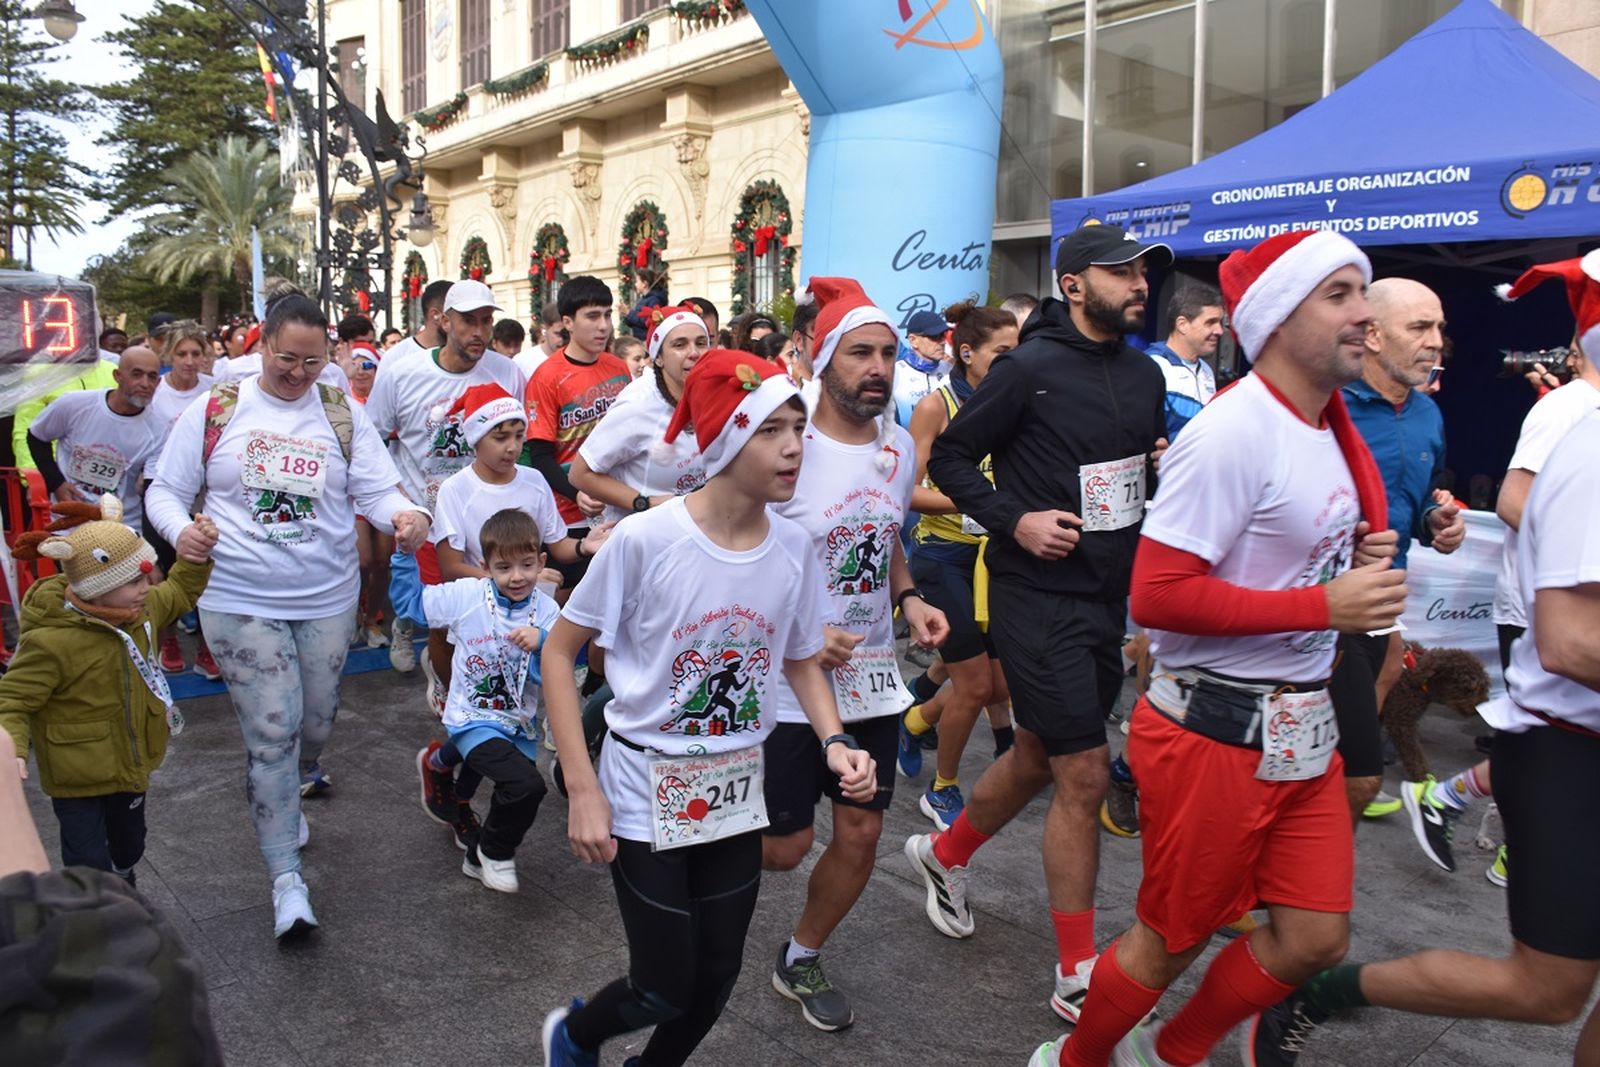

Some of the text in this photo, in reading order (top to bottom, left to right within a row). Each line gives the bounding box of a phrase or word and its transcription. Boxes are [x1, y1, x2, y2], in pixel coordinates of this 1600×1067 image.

[1551, 162, 1594, 179] MIS
[1211, 165, 1471, 206] CRONOMETRAJE ORGANIZACIÓN
[1105, 200, 1192, 222] MIS TIEMPOS
[1325, 199, 1337, 213] Y
[1203, 210, 1479, 244] GESTIÓN DE EVENTOS DEPORTIVOS
[891, 229, 985, 272] Ceuta
[23, 297, 76, 351] 13
[89, 462, 116, 478] 329
[280, 455, 319, 478] 189
[1123, 480, 1140, 504] 71
[1425, 597, 1493, 622] Ceuta
[867, 671, 897, 694] 174
[706, 775, 751, 812] 247
